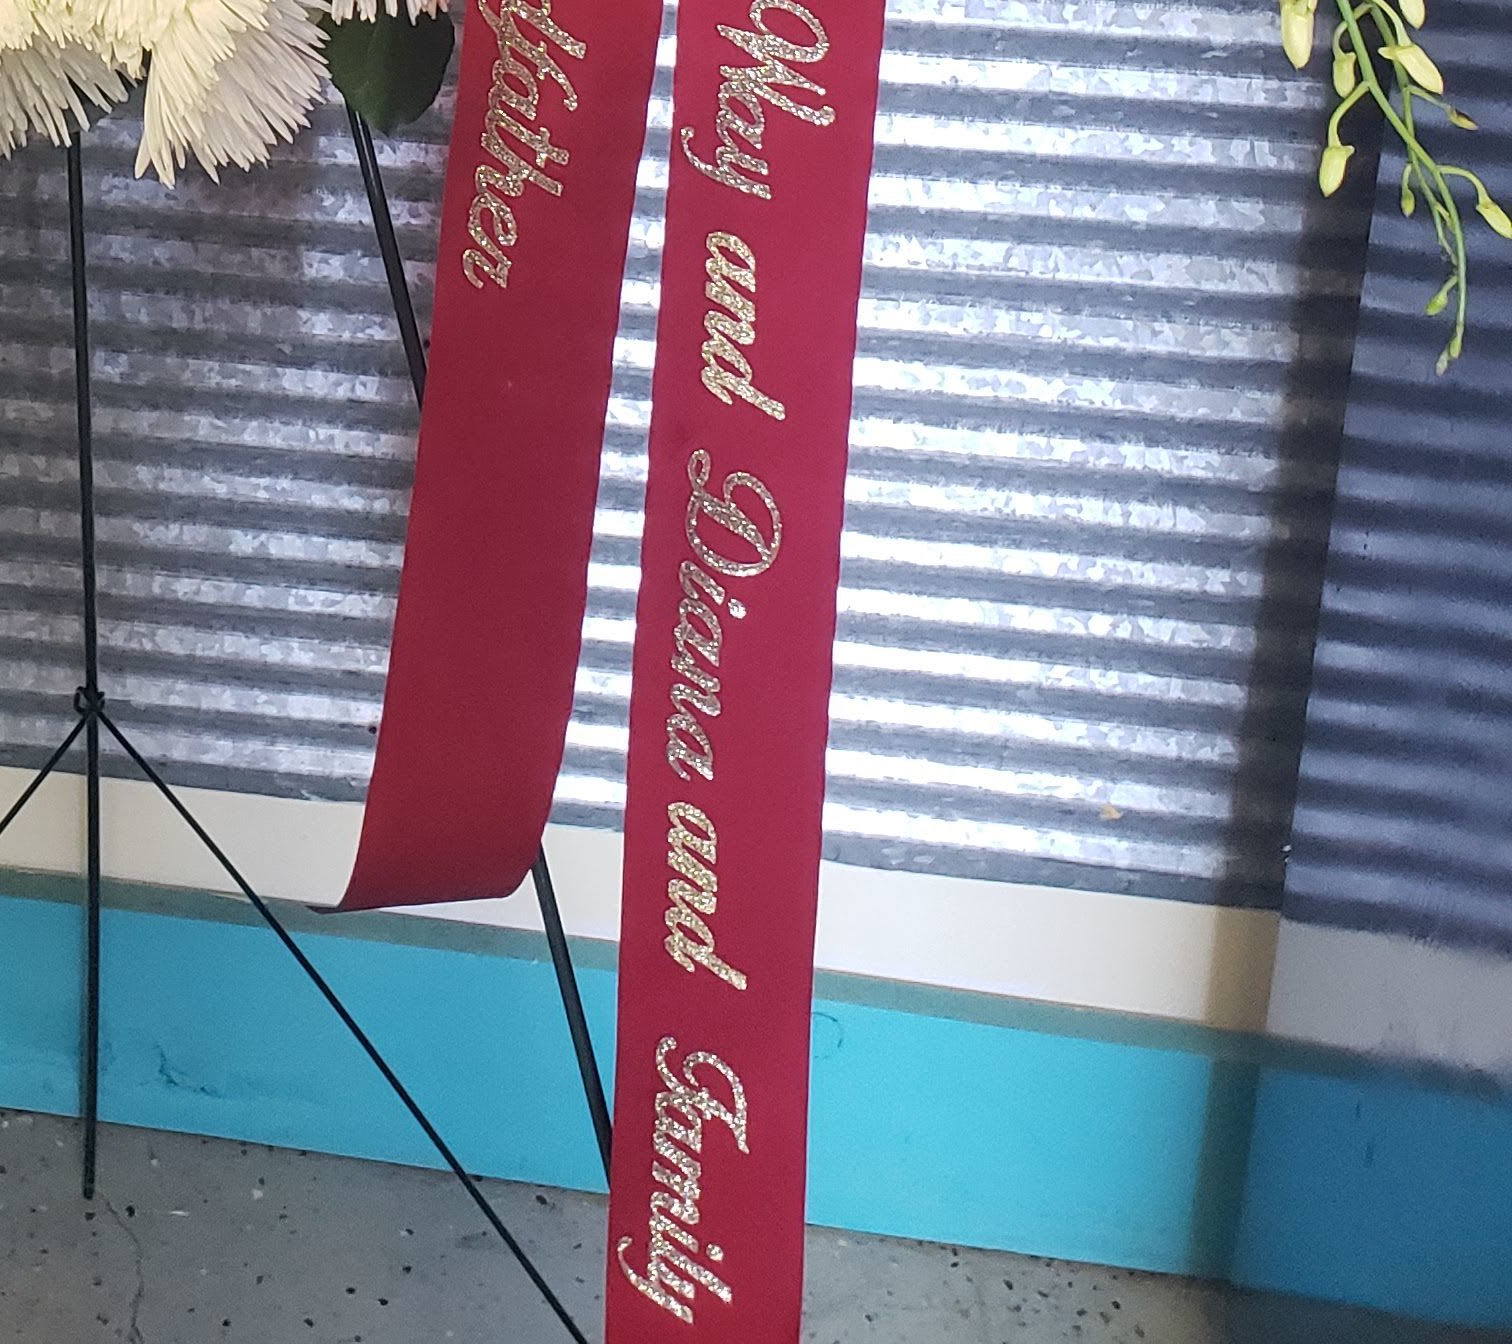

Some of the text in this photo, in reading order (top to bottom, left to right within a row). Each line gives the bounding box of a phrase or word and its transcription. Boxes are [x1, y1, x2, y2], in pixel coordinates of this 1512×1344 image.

[700, 230, 786, 421] and
[666, 448, 784, 782] Diana
[663, 800, 748, 992] and
[616, 1035, 751, 1325] Family
